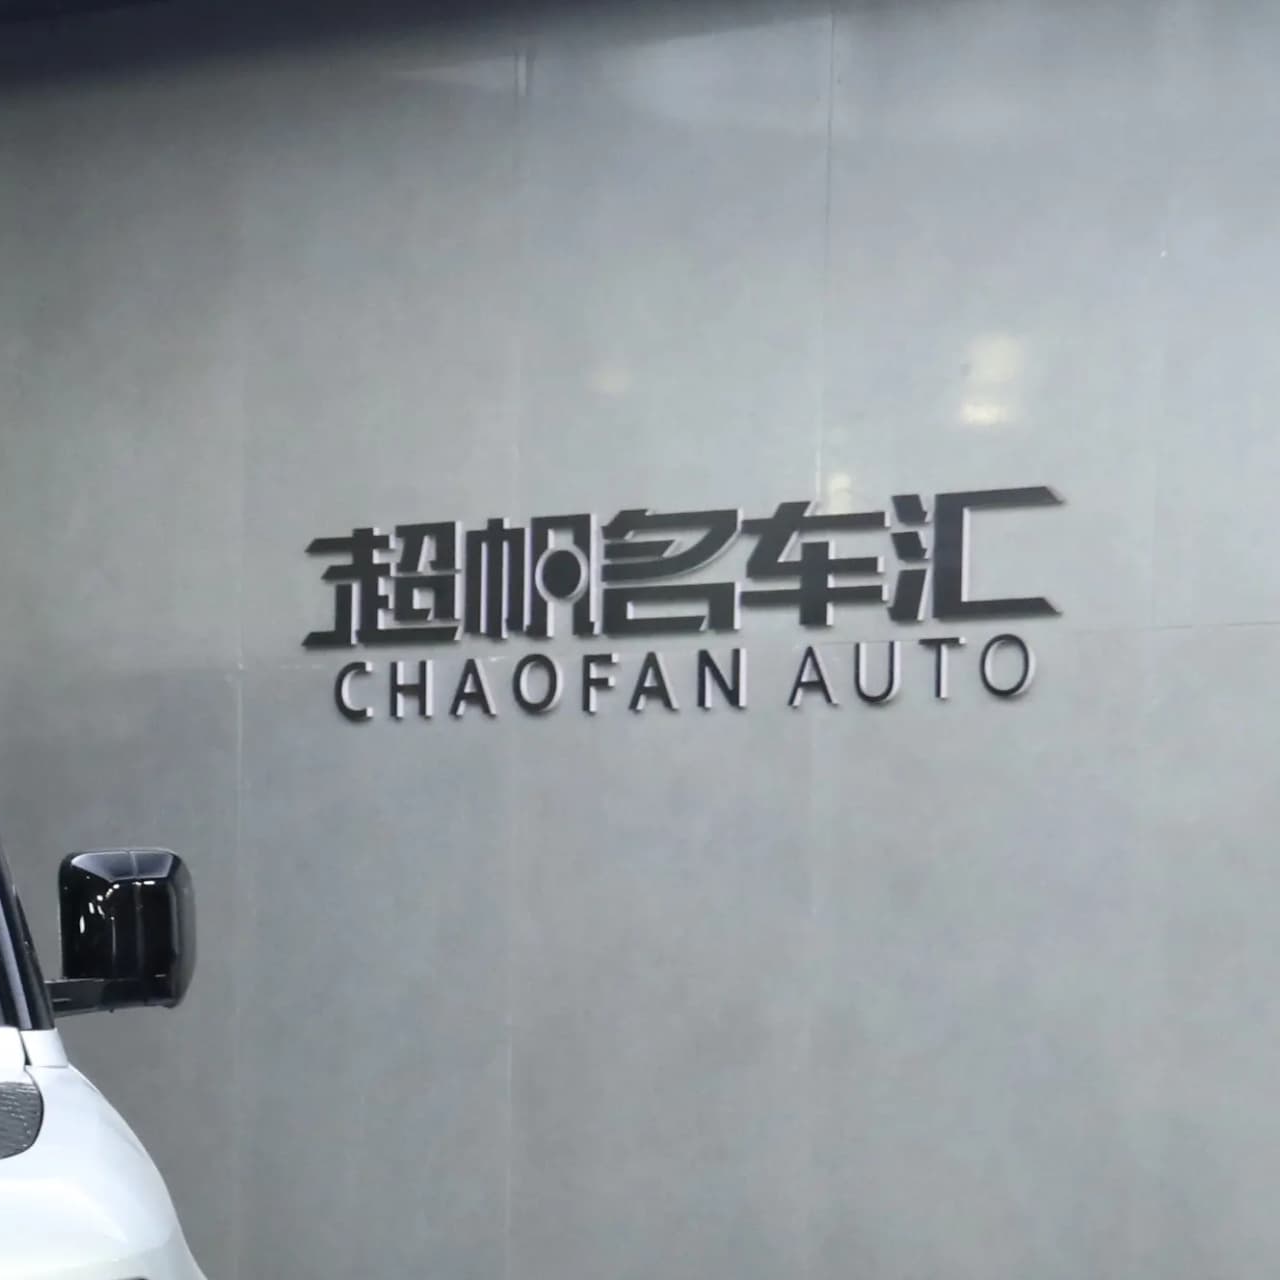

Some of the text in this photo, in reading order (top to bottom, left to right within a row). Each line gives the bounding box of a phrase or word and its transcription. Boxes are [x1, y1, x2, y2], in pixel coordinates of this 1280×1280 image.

[303, 486, 1064, 648] 超帆名车汇
[333, 633, 1035, 721] CHAOFAN AUTO
